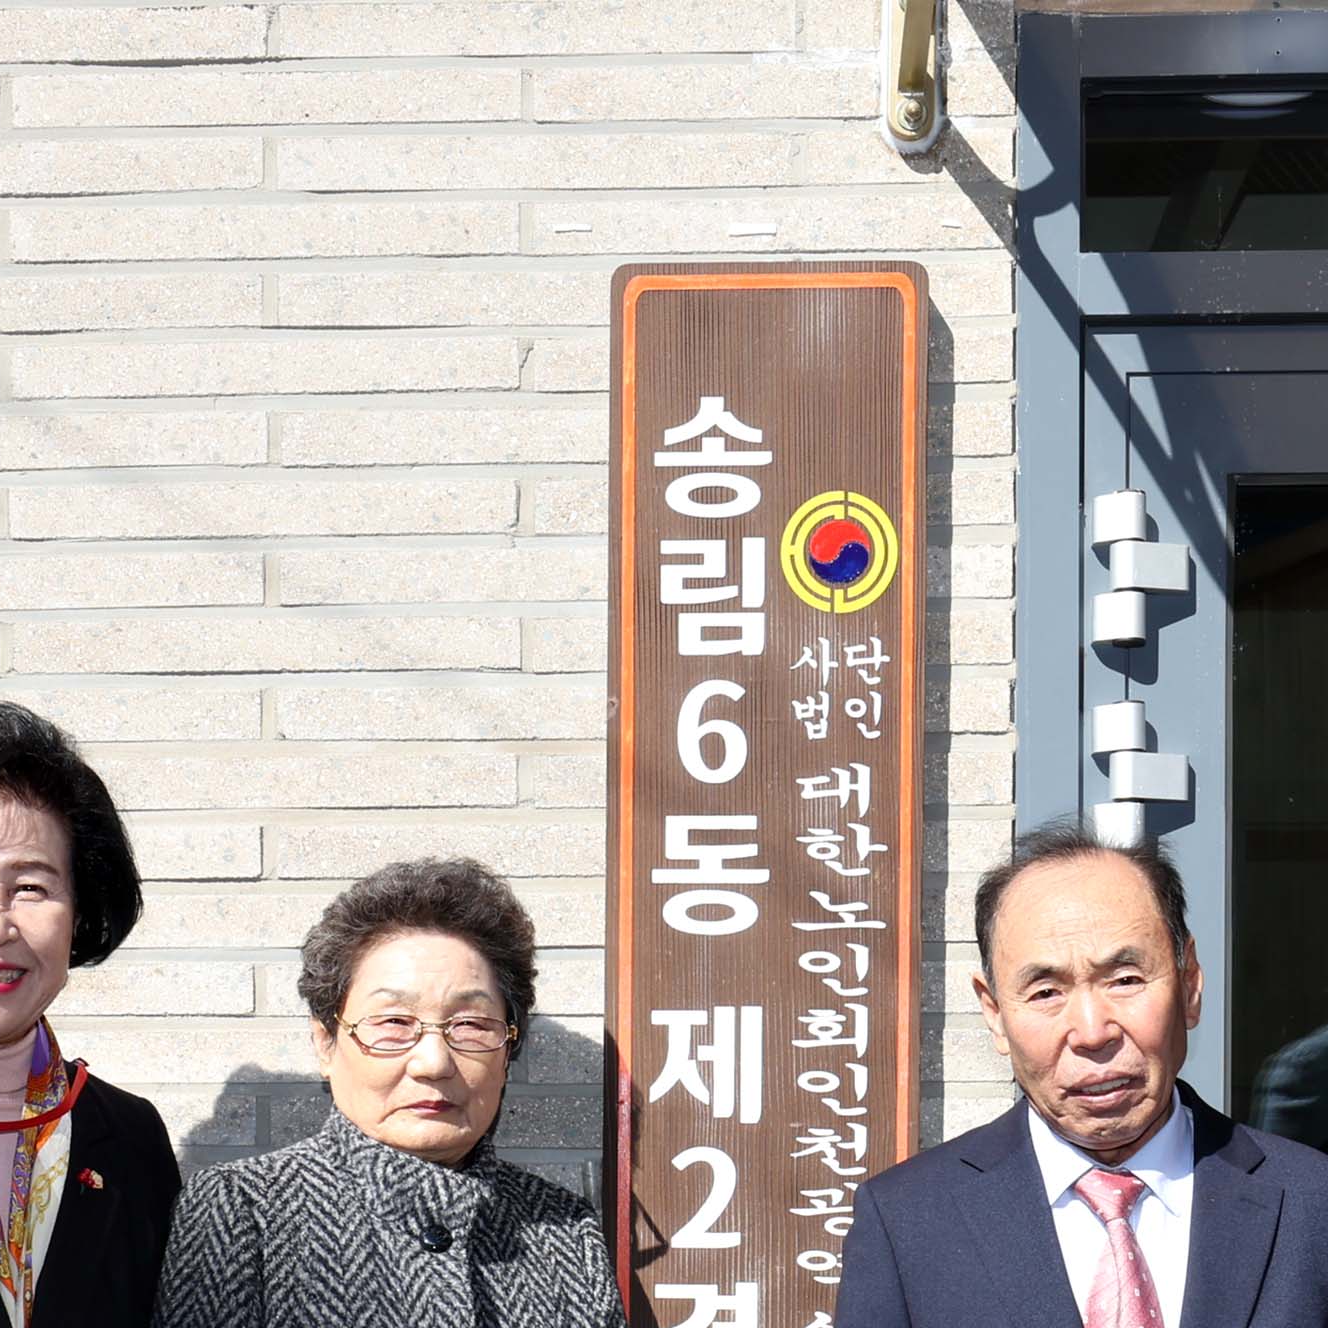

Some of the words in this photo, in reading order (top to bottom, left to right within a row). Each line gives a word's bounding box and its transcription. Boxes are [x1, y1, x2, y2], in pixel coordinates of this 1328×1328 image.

[651, 395, 773, 936] 송림6동
[789, 636, 891, 685] 사단
[791, 690, 882, 740] 법인
